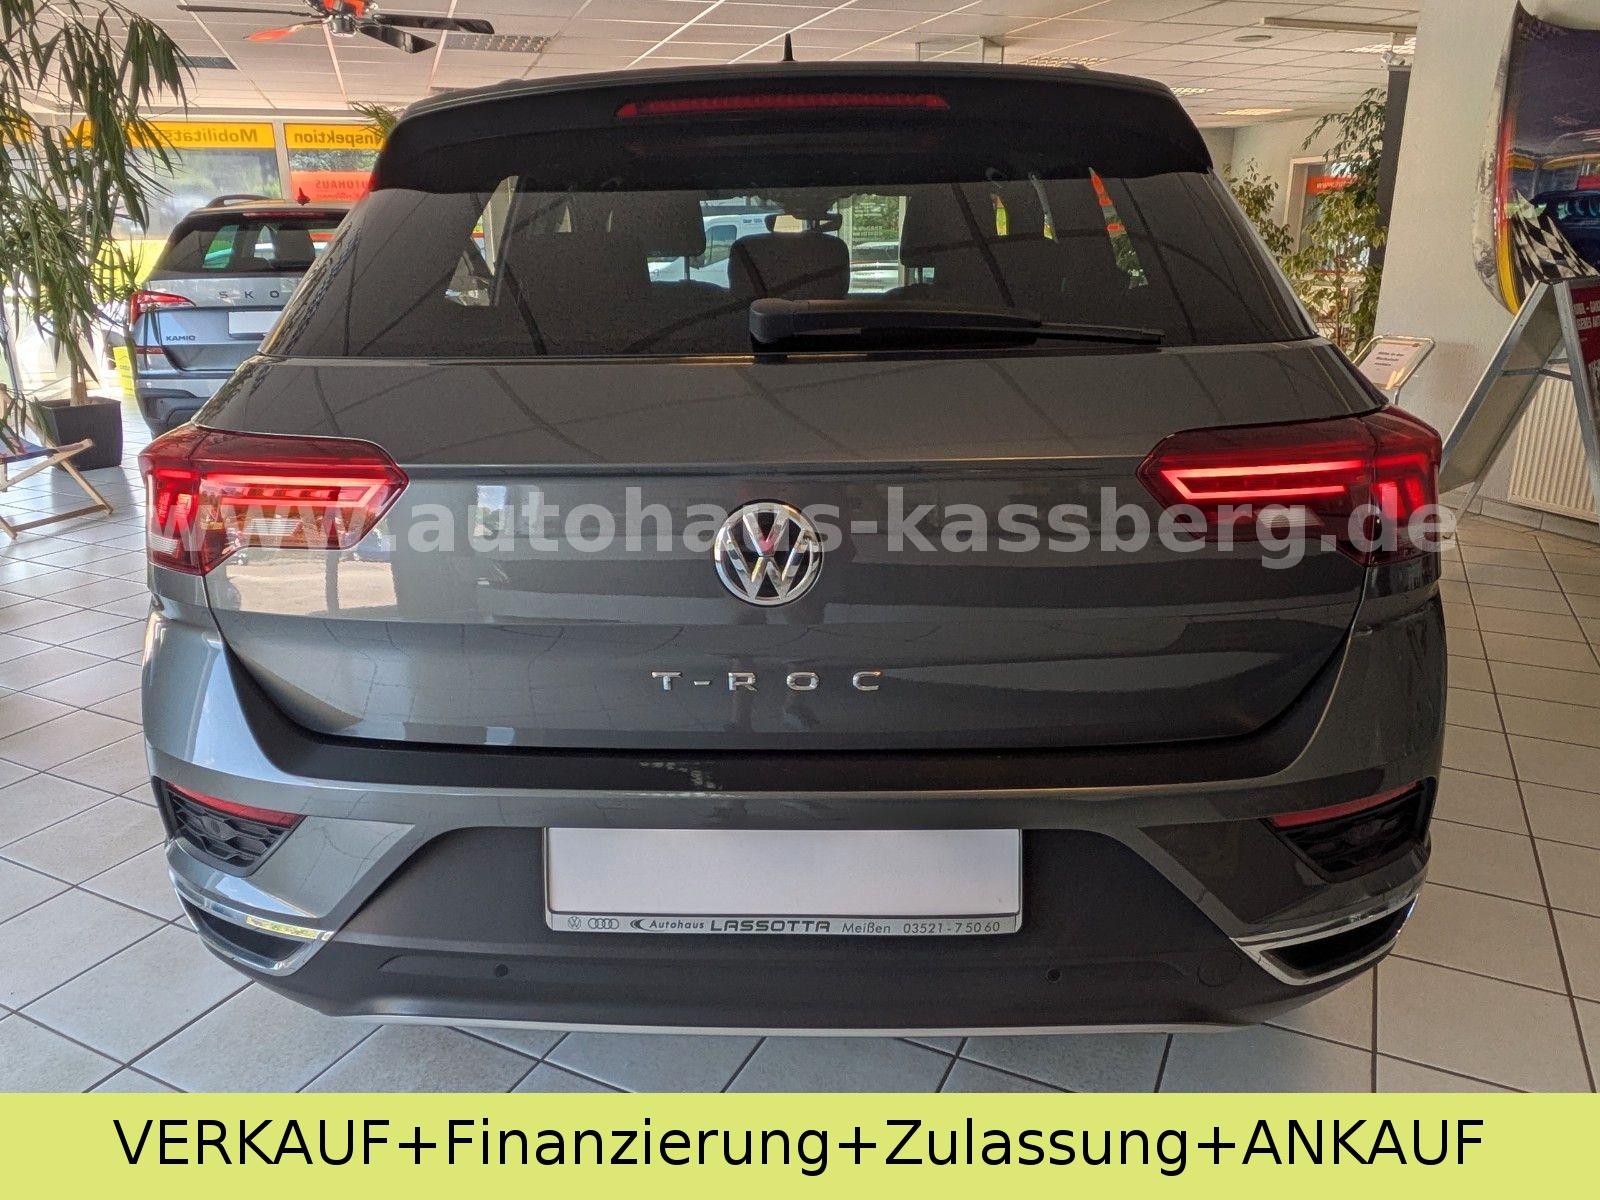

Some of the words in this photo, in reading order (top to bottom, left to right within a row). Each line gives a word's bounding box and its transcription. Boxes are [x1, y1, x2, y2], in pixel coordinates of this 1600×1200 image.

[651, 671, 882, 692] T-ROC
[649, 919, 705, 930] Autohaus
[710, 919, 831, 932] LASSOTTA
[842, 921, 891, 934] Meißen
